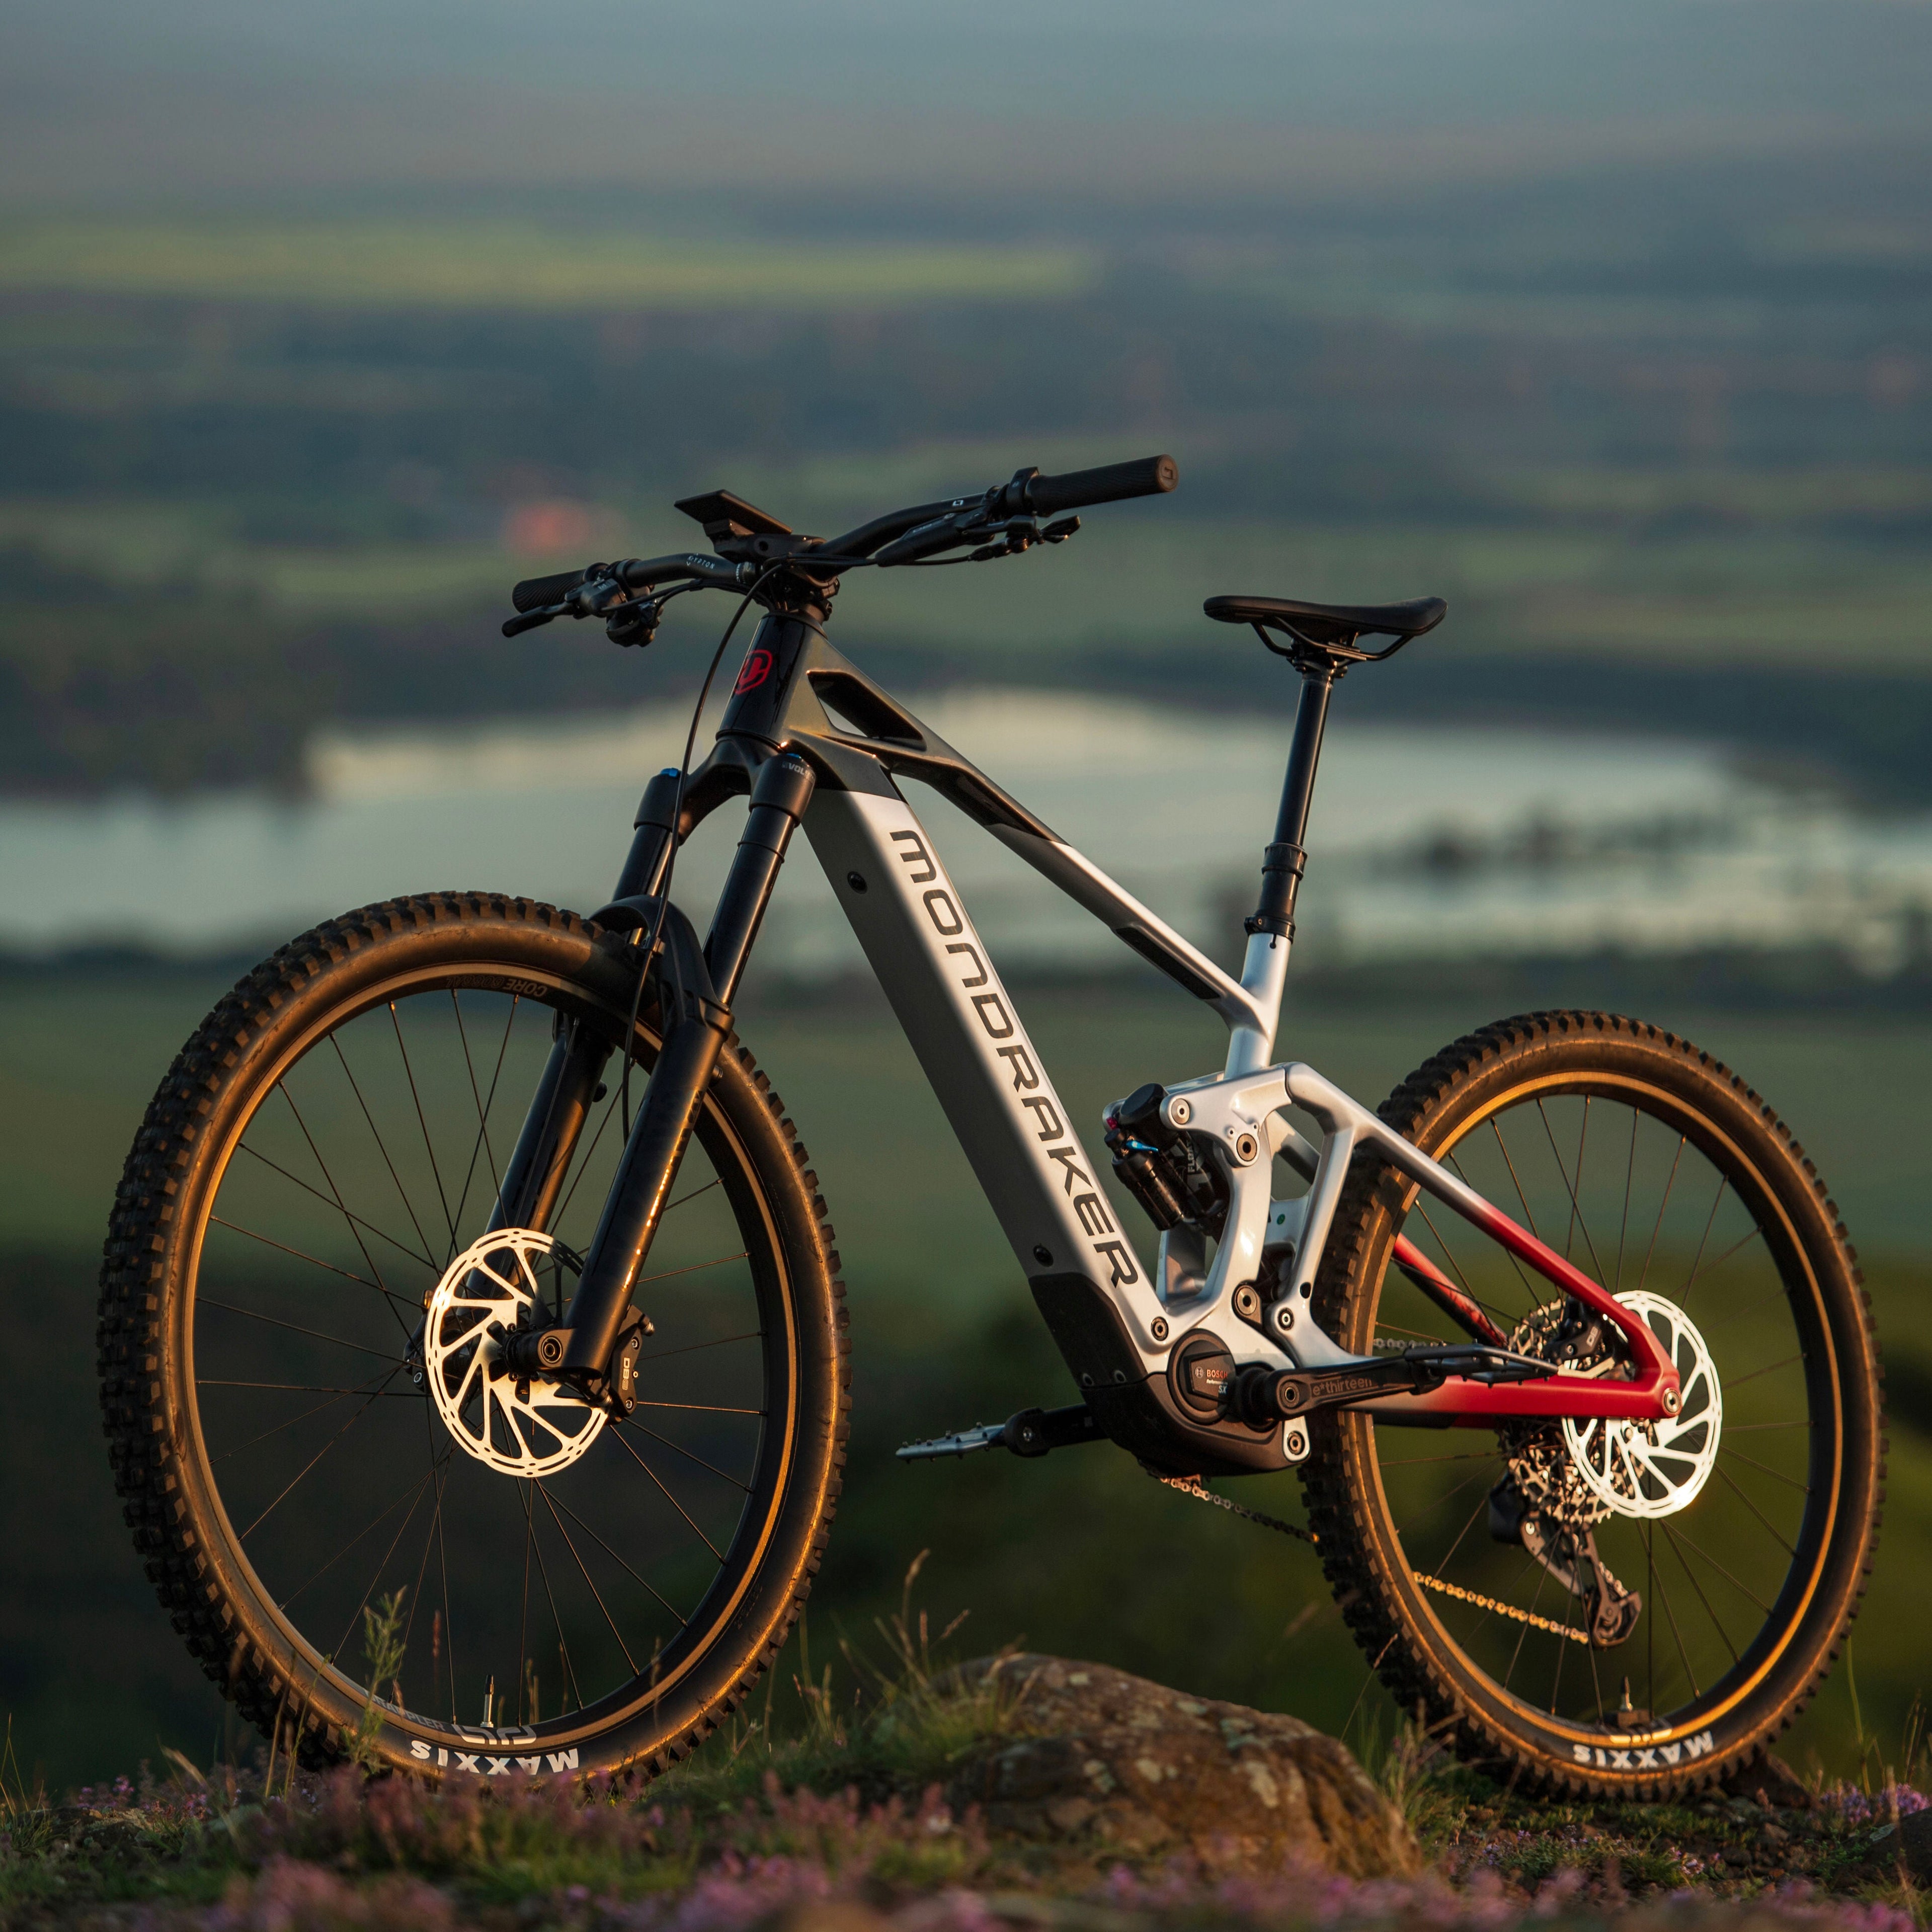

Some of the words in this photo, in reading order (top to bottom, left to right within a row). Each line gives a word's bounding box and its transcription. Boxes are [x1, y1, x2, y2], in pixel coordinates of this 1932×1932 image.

[503, 979, 548, 997] CORE
[890, 830, 1139, 1289] MONDRAKER
[1206, 1369, 1228, 1379] BOSCH
[1218, 1385, 1227, 1394] SX
[410, 1740, 579, 1776] MAXXIS
[1573, 1730, 1714, 1769] MAXXIS
